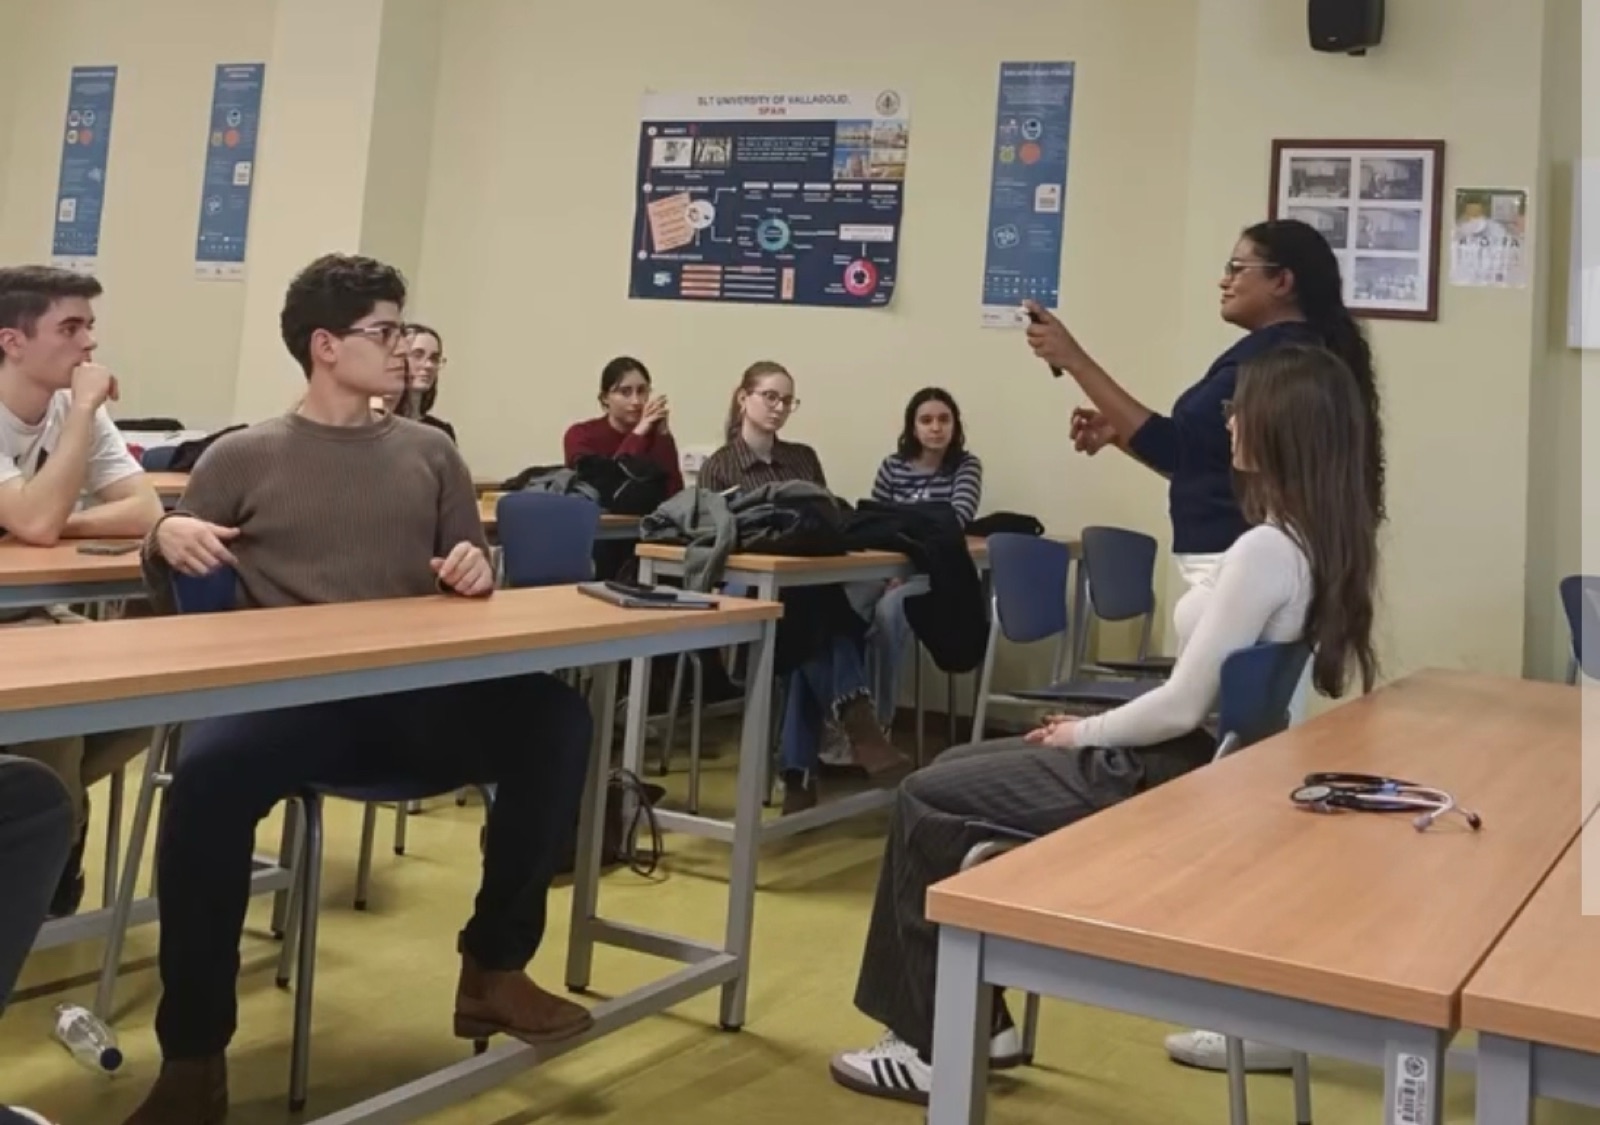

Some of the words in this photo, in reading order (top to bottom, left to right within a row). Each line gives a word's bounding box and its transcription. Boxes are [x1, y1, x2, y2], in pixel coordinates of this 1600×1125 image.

[716, 95, 770, 106] UNIVERSITY
[773, 94, 785, 105] OF
[758, 106, 786, 115] SPAIN
